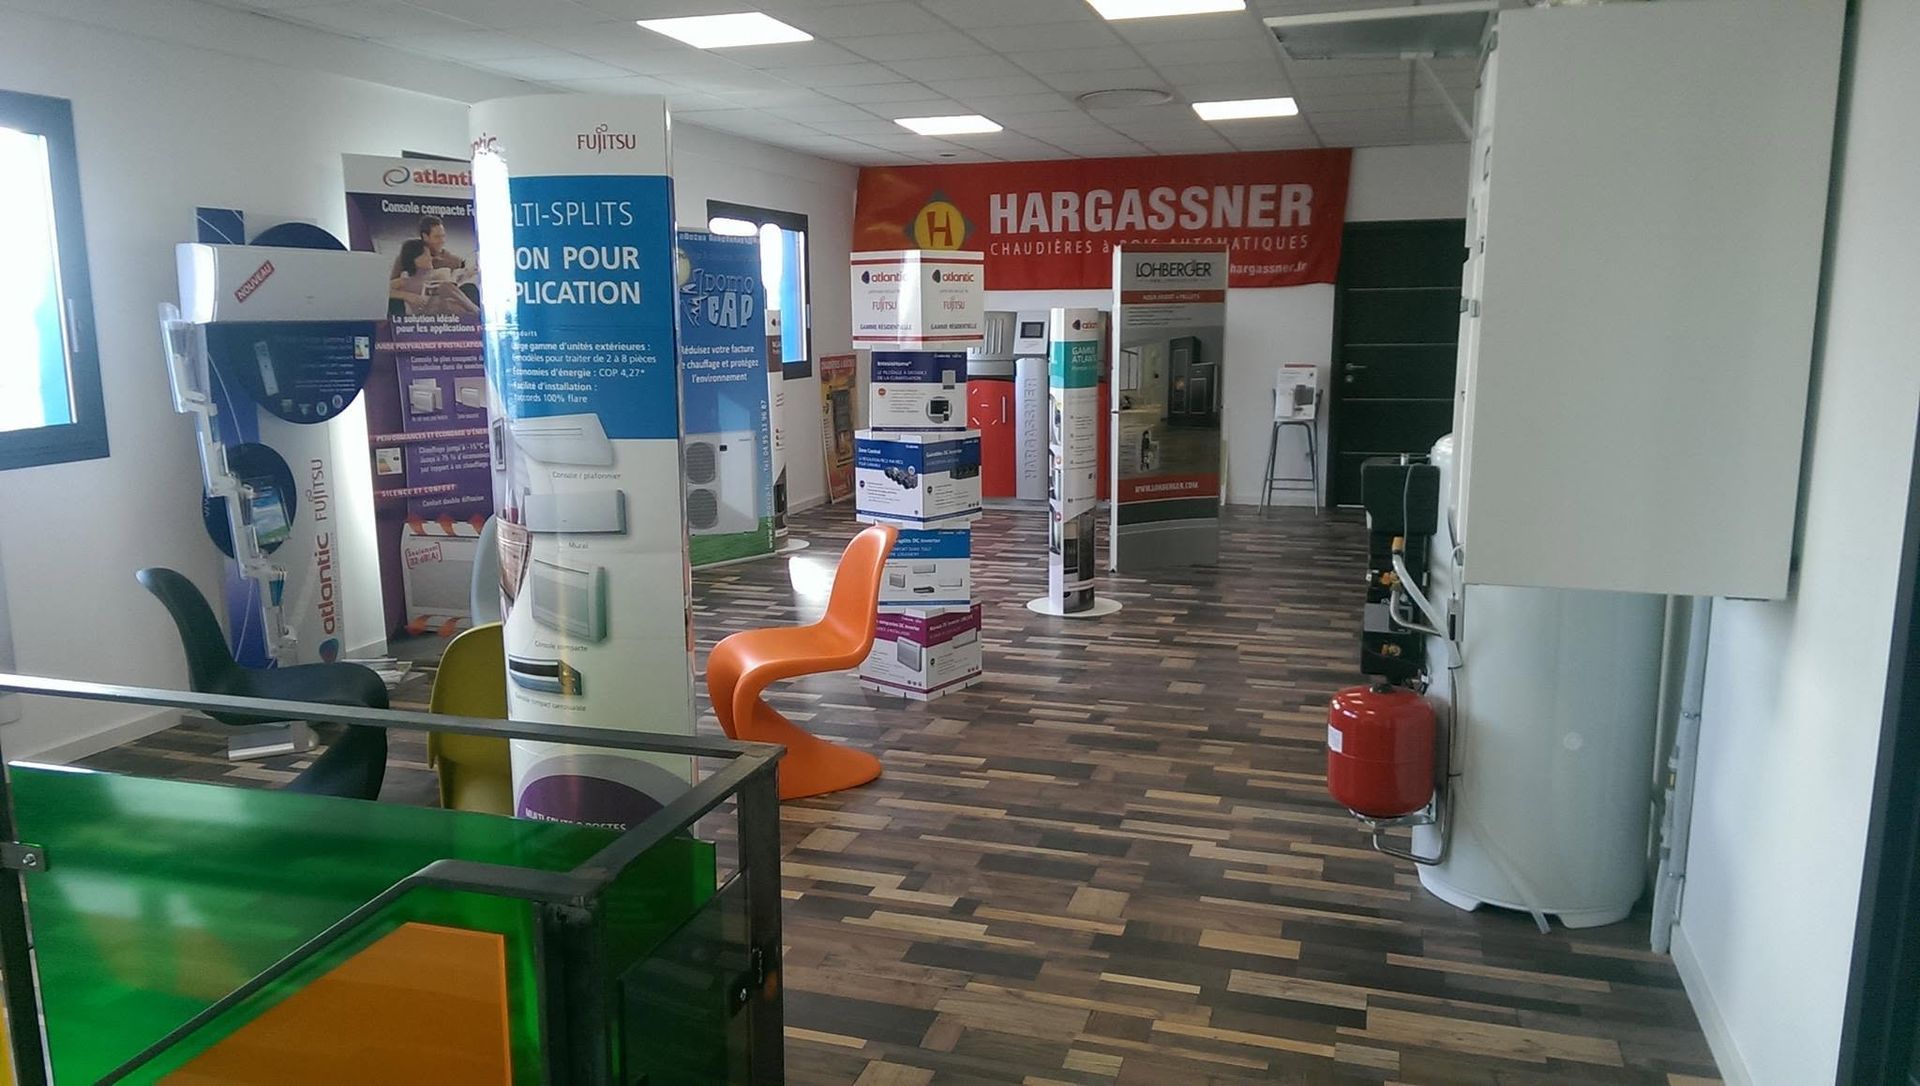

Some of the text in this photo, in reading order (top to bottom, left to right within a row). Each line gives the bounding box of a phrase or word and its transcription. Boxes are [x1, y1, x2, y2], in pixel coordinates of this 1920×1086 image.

[577, 128, 636, 153] FUJITSU
[413, 169, 473, 187] atlanti
[381, 200, 419, 214] Console
[421, 203, 465, 217] compacte
[514, 201, 633, 226] LTI-SPLITS
[989, 183, 1313, 234] HARGASSNER
[990, 240, 1093, 256] CHAUDIÈRES
[563, 246, 640, 270] POUR
[1135, 261, 1212, 278] LOHBERGER
[237, 262, 272, 300] NOUVEAU
[515, 281, 641, 305] PLICATION
[403, 314, 435, 323] solution
[430, 324, 475, 335] applications
[529, 343, 557, 352] gamme
[559, 342, 593, 351] d'unités
[595, 342, 646, 351] extérieures
[711, 345, 730, 354] votre
[731, 344, 755, 353] facture
[545, 356, 563, 364] pour
[565, 354, 591, 362] traiter
[593, 354, 605, 363] de
[606, 355, 612, 363] 2
[621, 354, 628, 363] 8
[629, 354, 657, 364] pièces
[550, 367, 591, 379] d'énergie
[599, 368, 618, 377] COP
[692, 373, 748, 384] l'environnement
[538, 382, 592, 391] d'installation
[543, 394, 565, 402] 100%
[568, 394, 588, 403] flare
[308, 458, 329, 522] FUJITSU
[315, 532, 336, 635] atlantic
